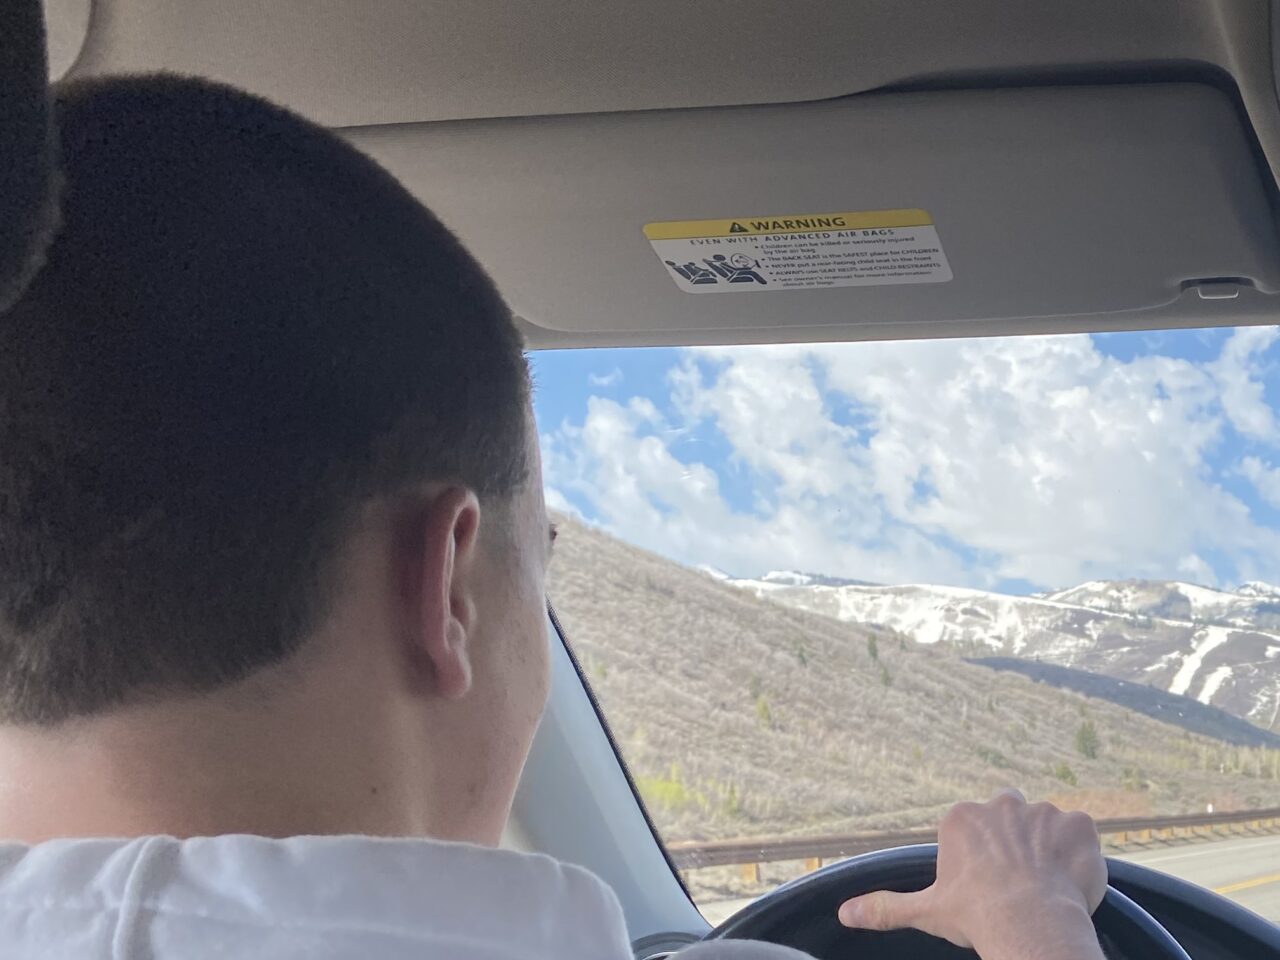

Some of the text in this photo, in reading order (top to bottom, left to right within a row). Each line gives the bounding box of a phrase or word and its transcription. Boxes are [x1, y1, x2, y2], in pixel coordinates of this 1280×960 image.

[750, 217, 846, 231] WARNING
[765, 232, 830, 242] ADVANCED
[863, 229, 895, 237] BAGS
